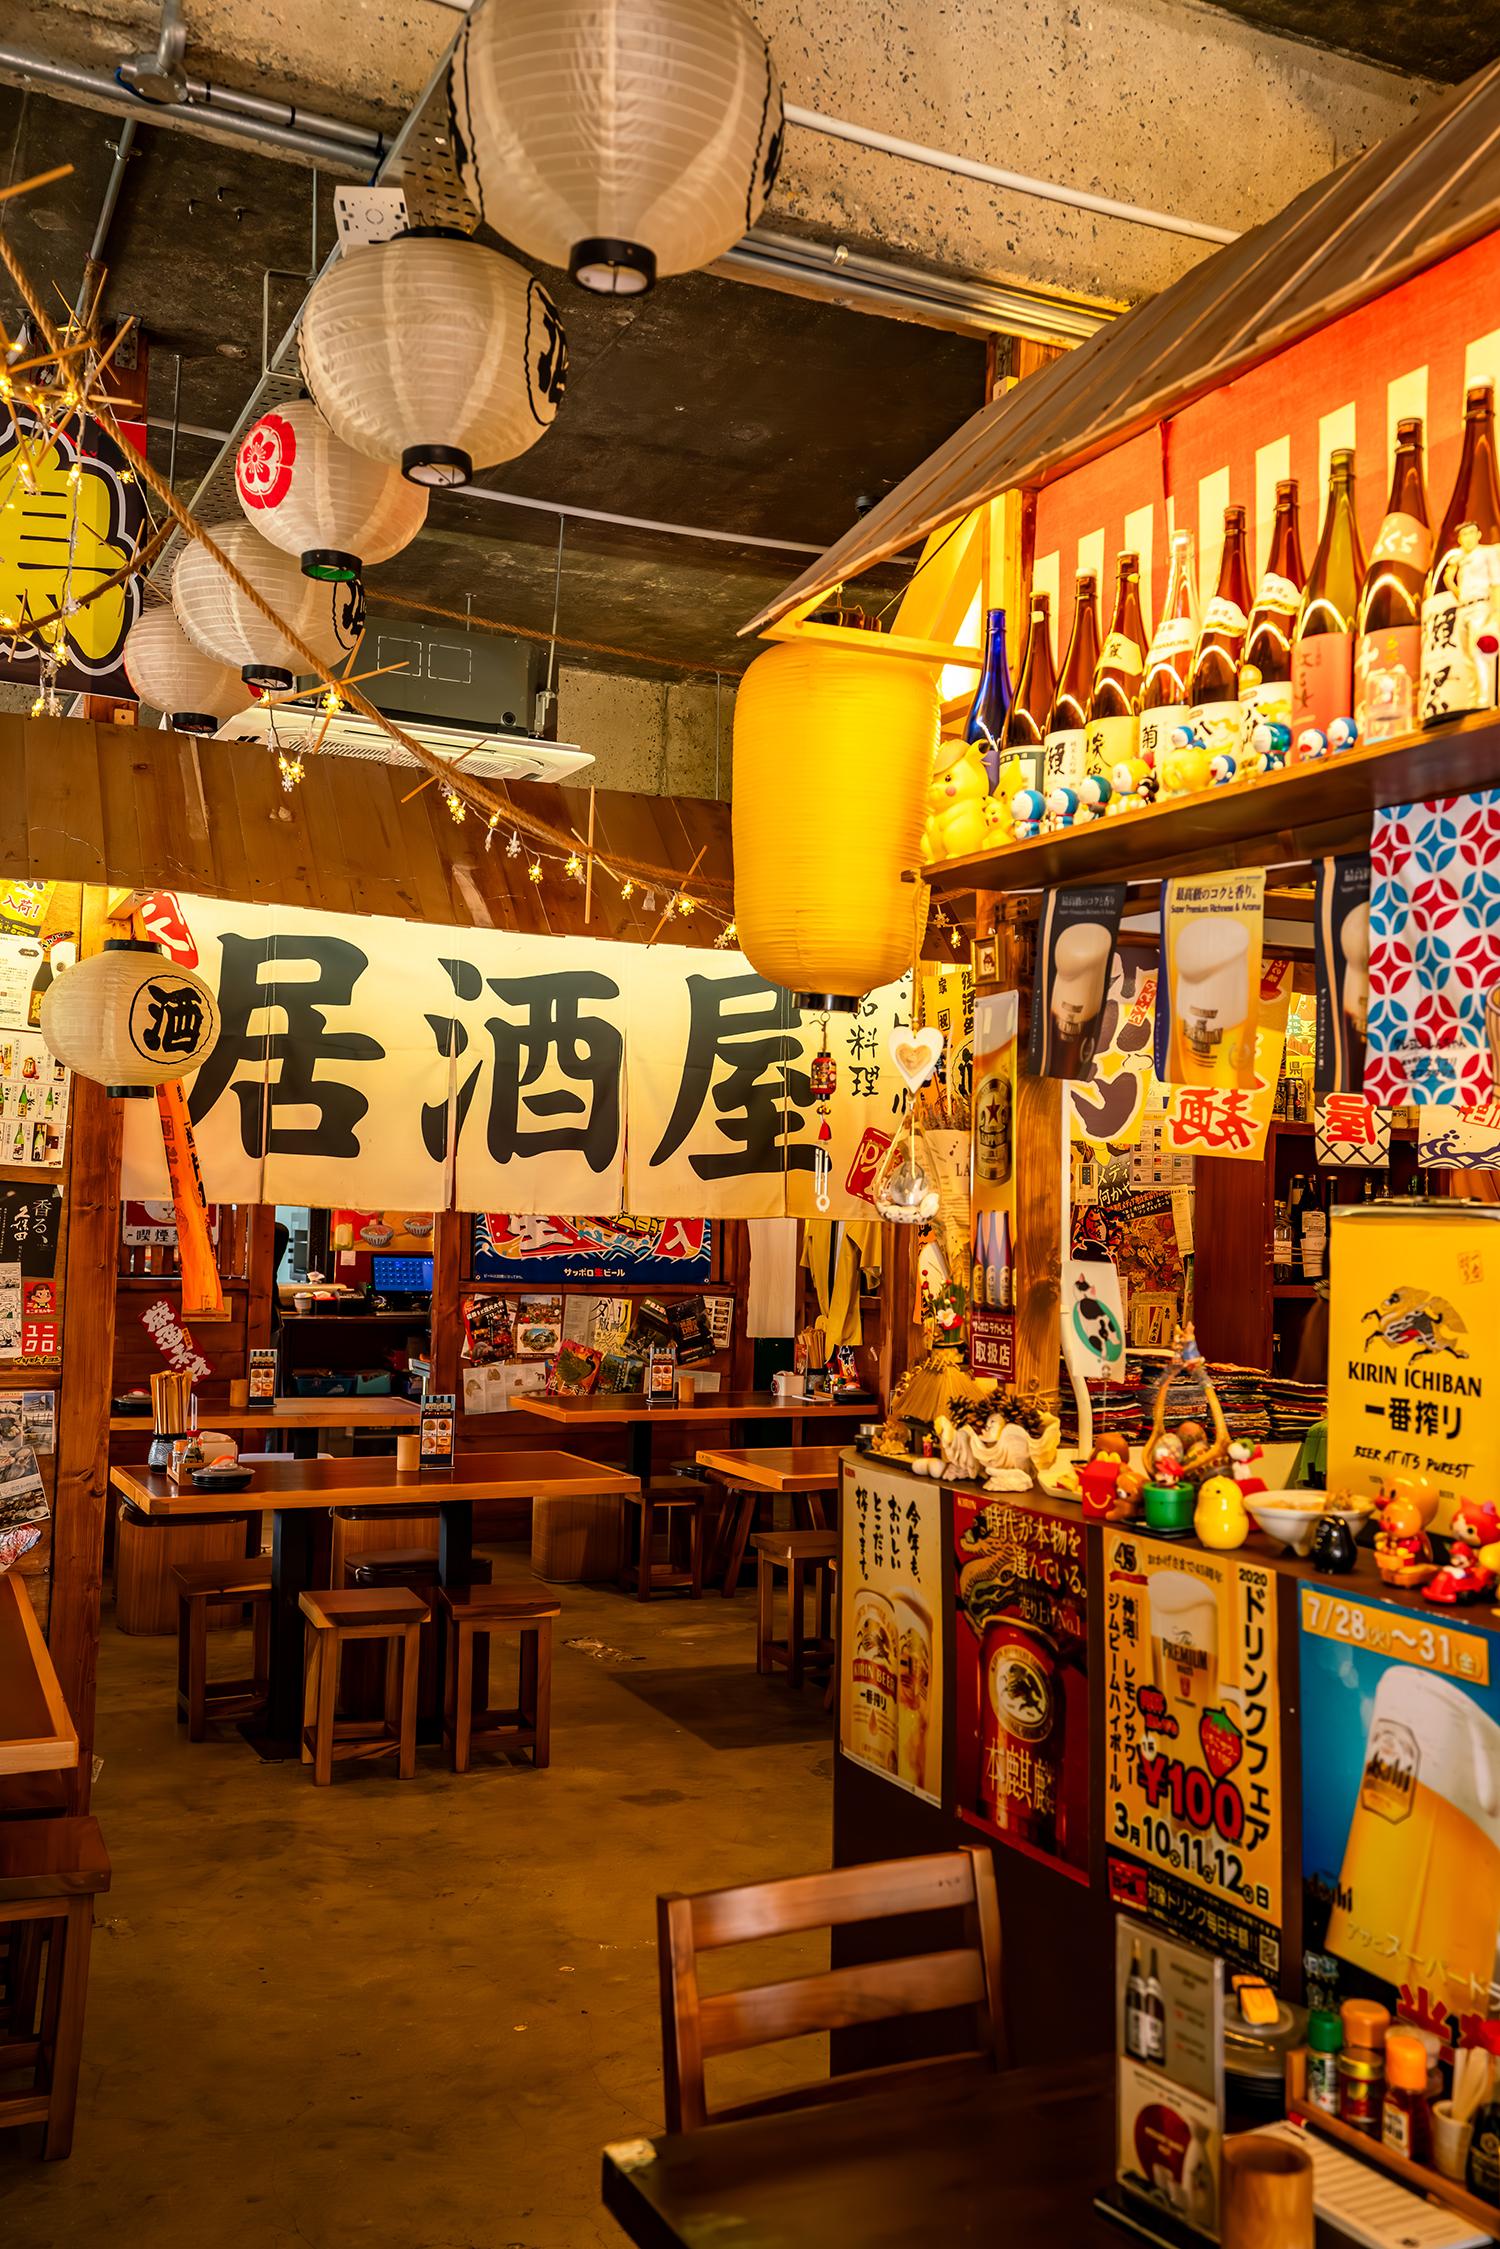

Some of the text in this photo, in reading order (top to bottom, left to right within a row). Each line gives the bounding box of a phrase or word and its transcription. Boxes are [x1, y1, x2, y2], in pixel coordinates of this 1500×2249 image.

[143, 985, 202, 1053] 酒
[564, 1267, 626, 1278] サッポロ生ビール
[25, 1340, 53, 1352] クロ
[27, 1325, 54, 1337] ユニ
[974, 1340, 1010, 1366] 取扱店
[1349, 1361, 1482, 1398] KIRIN ICHIBAN
[1365, 1397, 1462, 1440] 一番搾り
[905, 1500, 921, 1584] 今年も、
[981, 1504, 1082, 1558] 時代が本物を
[1012, 1546, 1088, 1598] 選んでいる。
[1238, 1567, 1268, 1588] 2020
[1162, 1637, 1208, 1671] PREMIUM
[1108, 1592, 1122, 1793] ジムビームハイボール
[1244, 1585, 1271, 1852] ドリンクフェア
